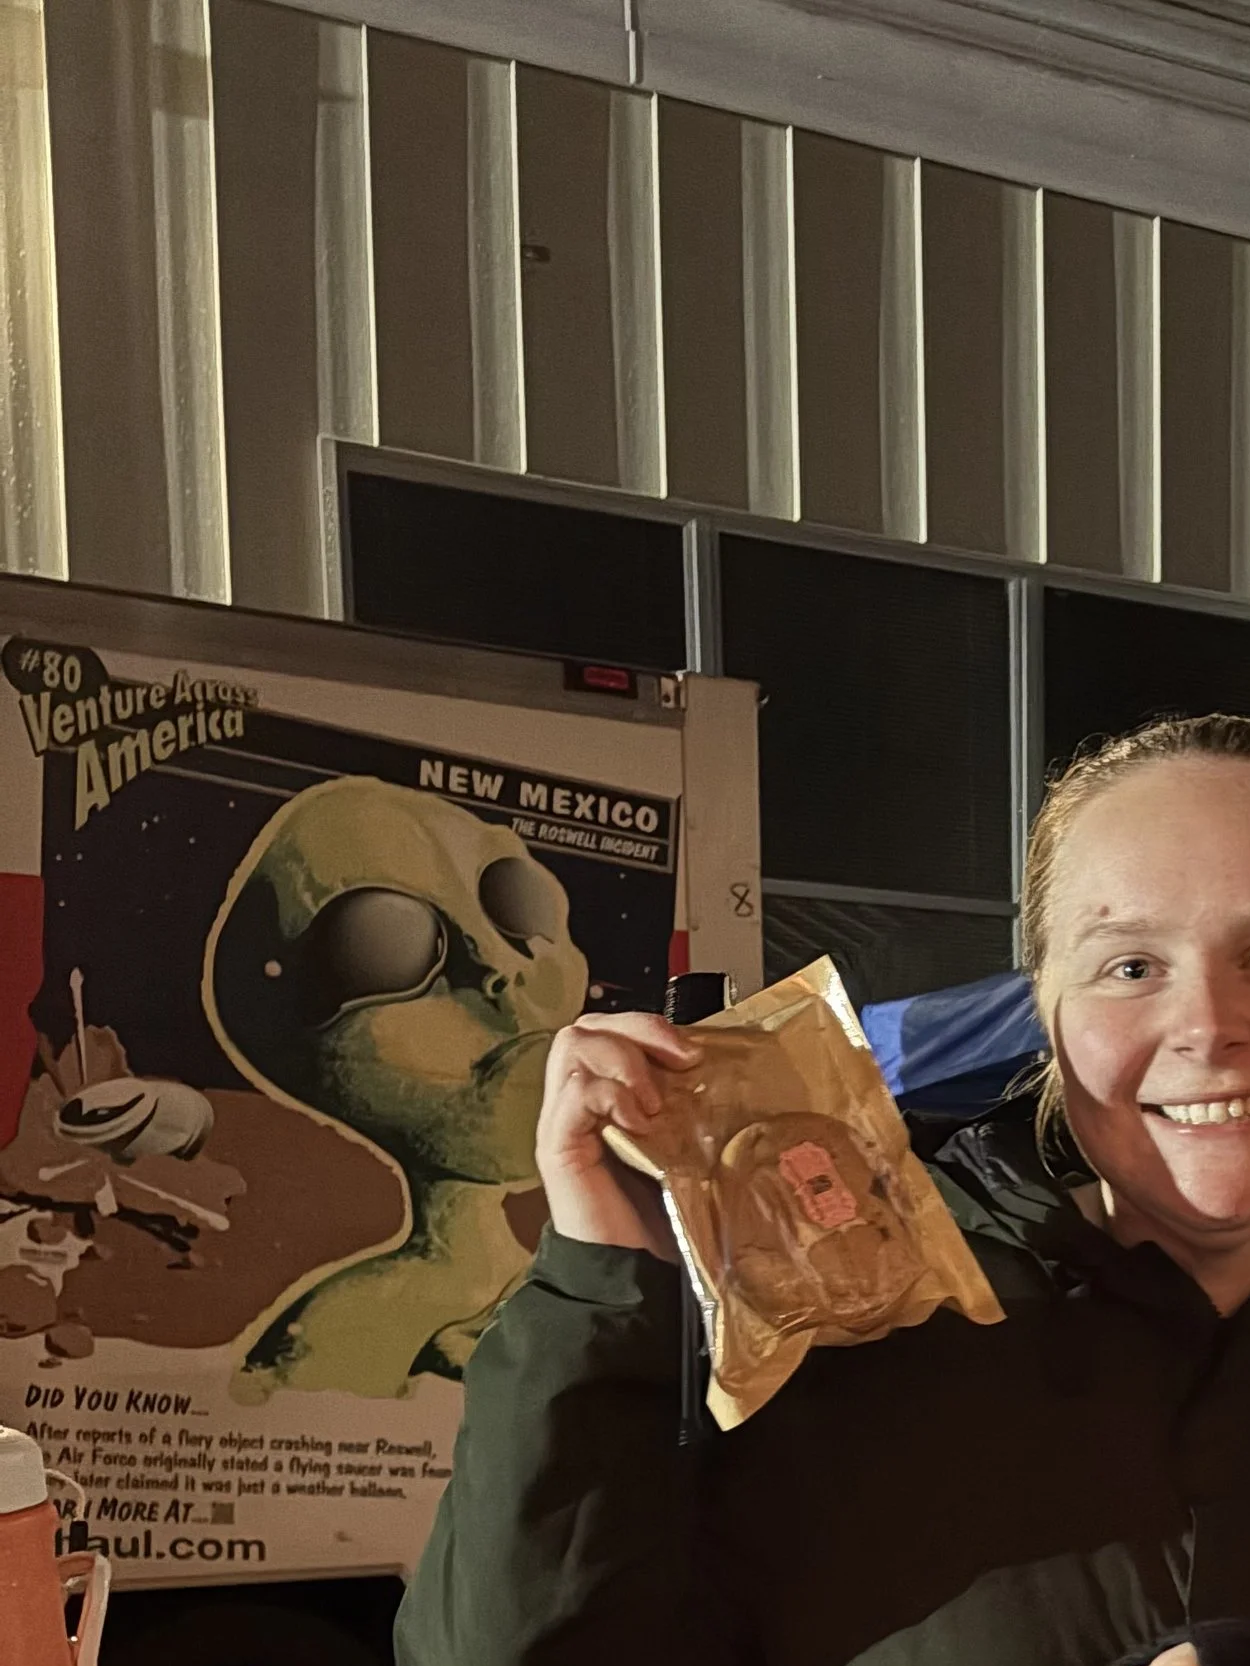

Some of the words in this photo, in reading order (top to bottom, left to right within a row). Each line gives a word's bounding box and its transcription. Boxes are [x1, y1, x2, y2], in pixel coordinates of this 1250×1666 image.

[20, 649, 82, 693] #80
[20, 681, 166, 752] Venture
[172, 669, 259, 707] Across
[75, 702, 244, 831] America
[419, 760, 504, 801] NEW
[519, 781, 659, 833] MEXICO
[512, 817, 536, 837] THE
[537, 823, 598, 850] ROSWELL
[600, 836, 660, 861] INCIDENT
[730, 882, 754, 917] 8
[25, 1384, 65, 1408] DID
[75, 1385, 118, 1412] YOU
[26, 1421, 70, 1440] After
[76, 1427, 132, 1445] reports
[139, 1426, 156, 1445] of
[162, 1432, 172, 1445] a
[179, 1429, 213, 1450] fiery
[219, 1431, 264, 1453] object
[271, 1434, 332, 1456] crashing
[57, 1446, 84, 1465] Air
[92, 1446, 137, 1467] Force
[143, 1451, 215, 1473] originally
[222, 1455, 268, 1472] stated
[274, 1461, 283, 1472] a
[290, 1456, 331, 1479] flying
[337, 1463, 382, 1476] saucer
[388, 1467, 415, 1478] was
[116, 1471, 179, 1491] claimed
[185, 1475, 195, 1492] it
[202, 1479, 232, 1493] was
[238, 1476, 265, 1497] just
[271, 1481, 281, 1494] a
[286, 1480, 345, 1497] weather
[97, 1496, 159, 1521] MORE
